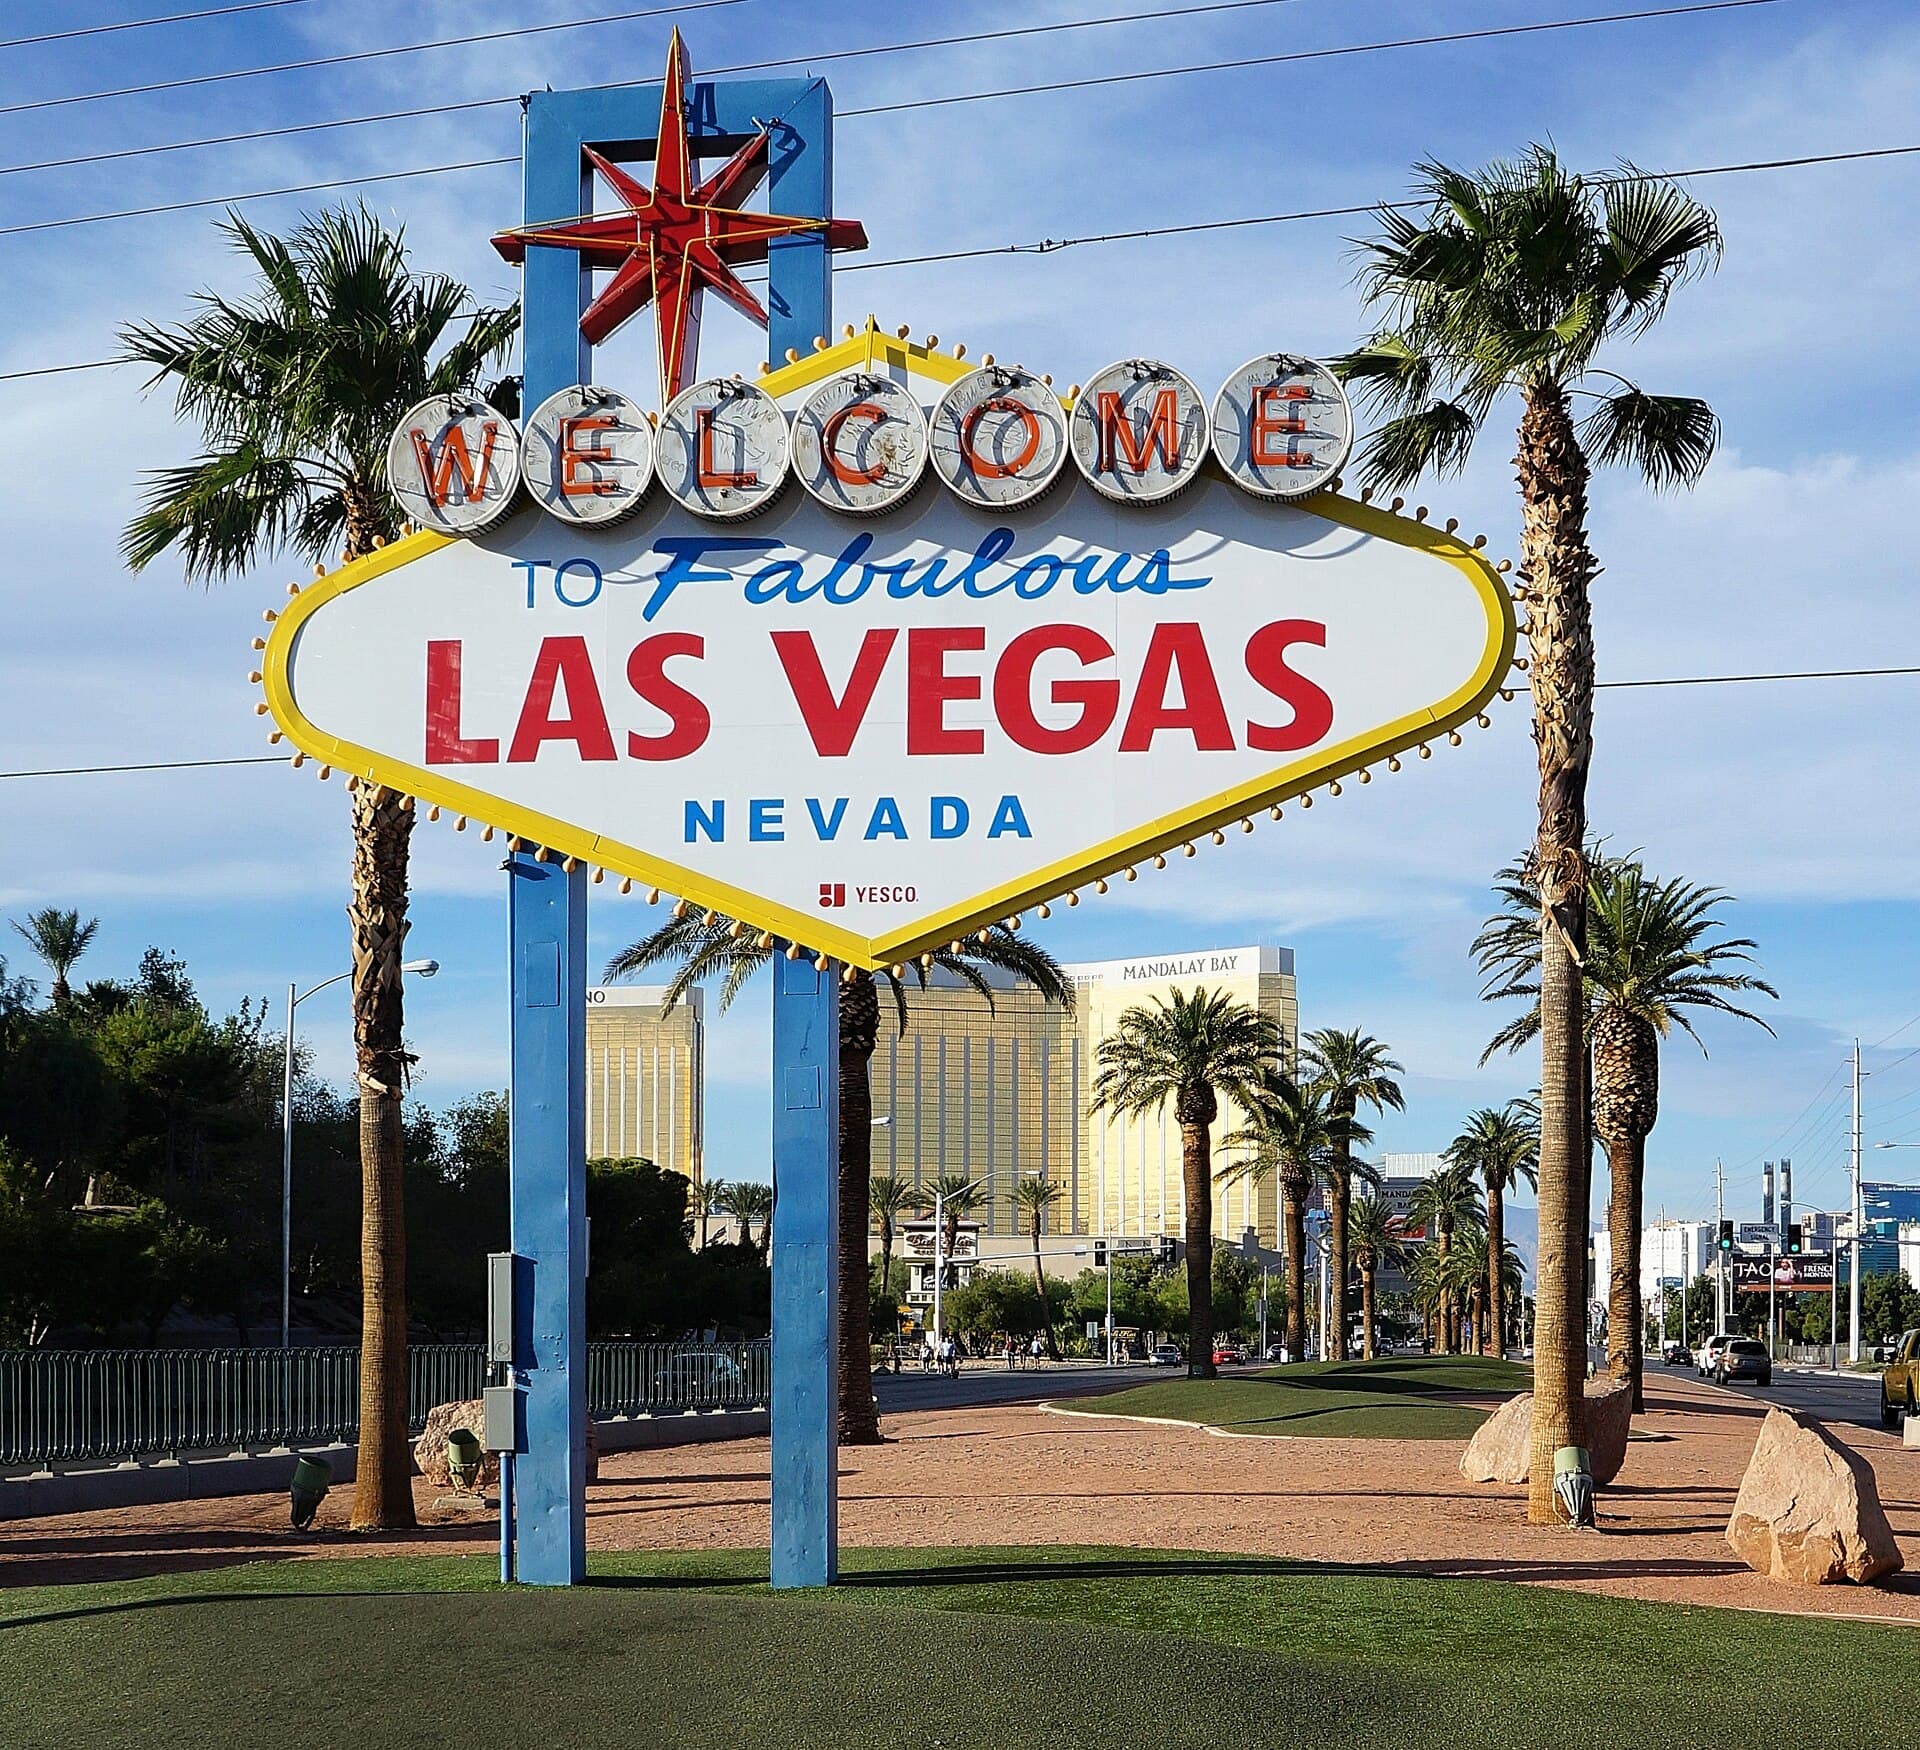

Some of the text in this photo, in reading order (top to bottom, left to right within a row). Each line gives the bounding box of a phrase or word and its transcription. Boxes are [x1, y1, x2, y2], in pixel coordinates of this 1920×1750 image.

[409, 386, 1314, 508] WELCOME
[511, 527, 1213, 622] TO Fabulous
[425, 619, 1334, 765] LAS VEGAS
[684, 795, 1033, 843] NEVADA
[855, 886, 917, 903] YESCO
[1123, 956, 1238, 979] MANDALAY BAY
[1733, 1261, 1772, 1278] TAO
